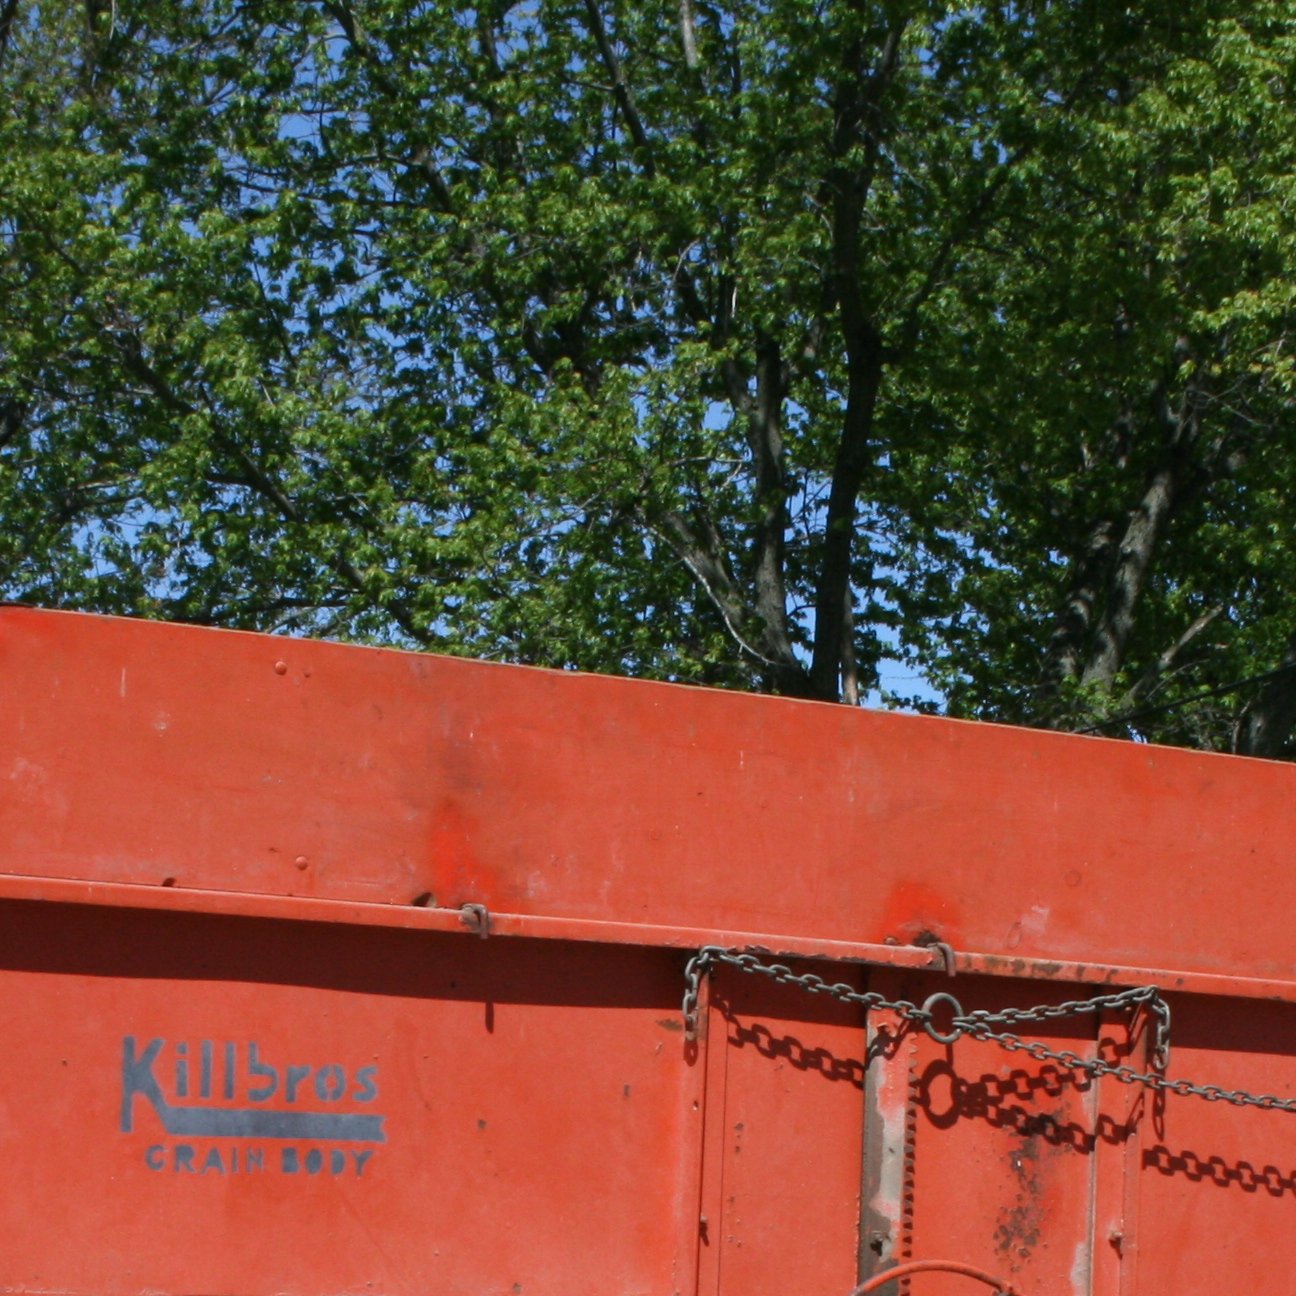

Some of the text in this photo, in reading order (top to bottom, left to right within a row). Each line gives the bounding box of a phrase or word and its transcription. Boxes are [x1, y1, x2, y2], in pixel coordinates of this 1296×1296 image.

[120, 1035, 386, 1140] Killbros
[144, 1144, 373, 1175] GRAIN BODY
